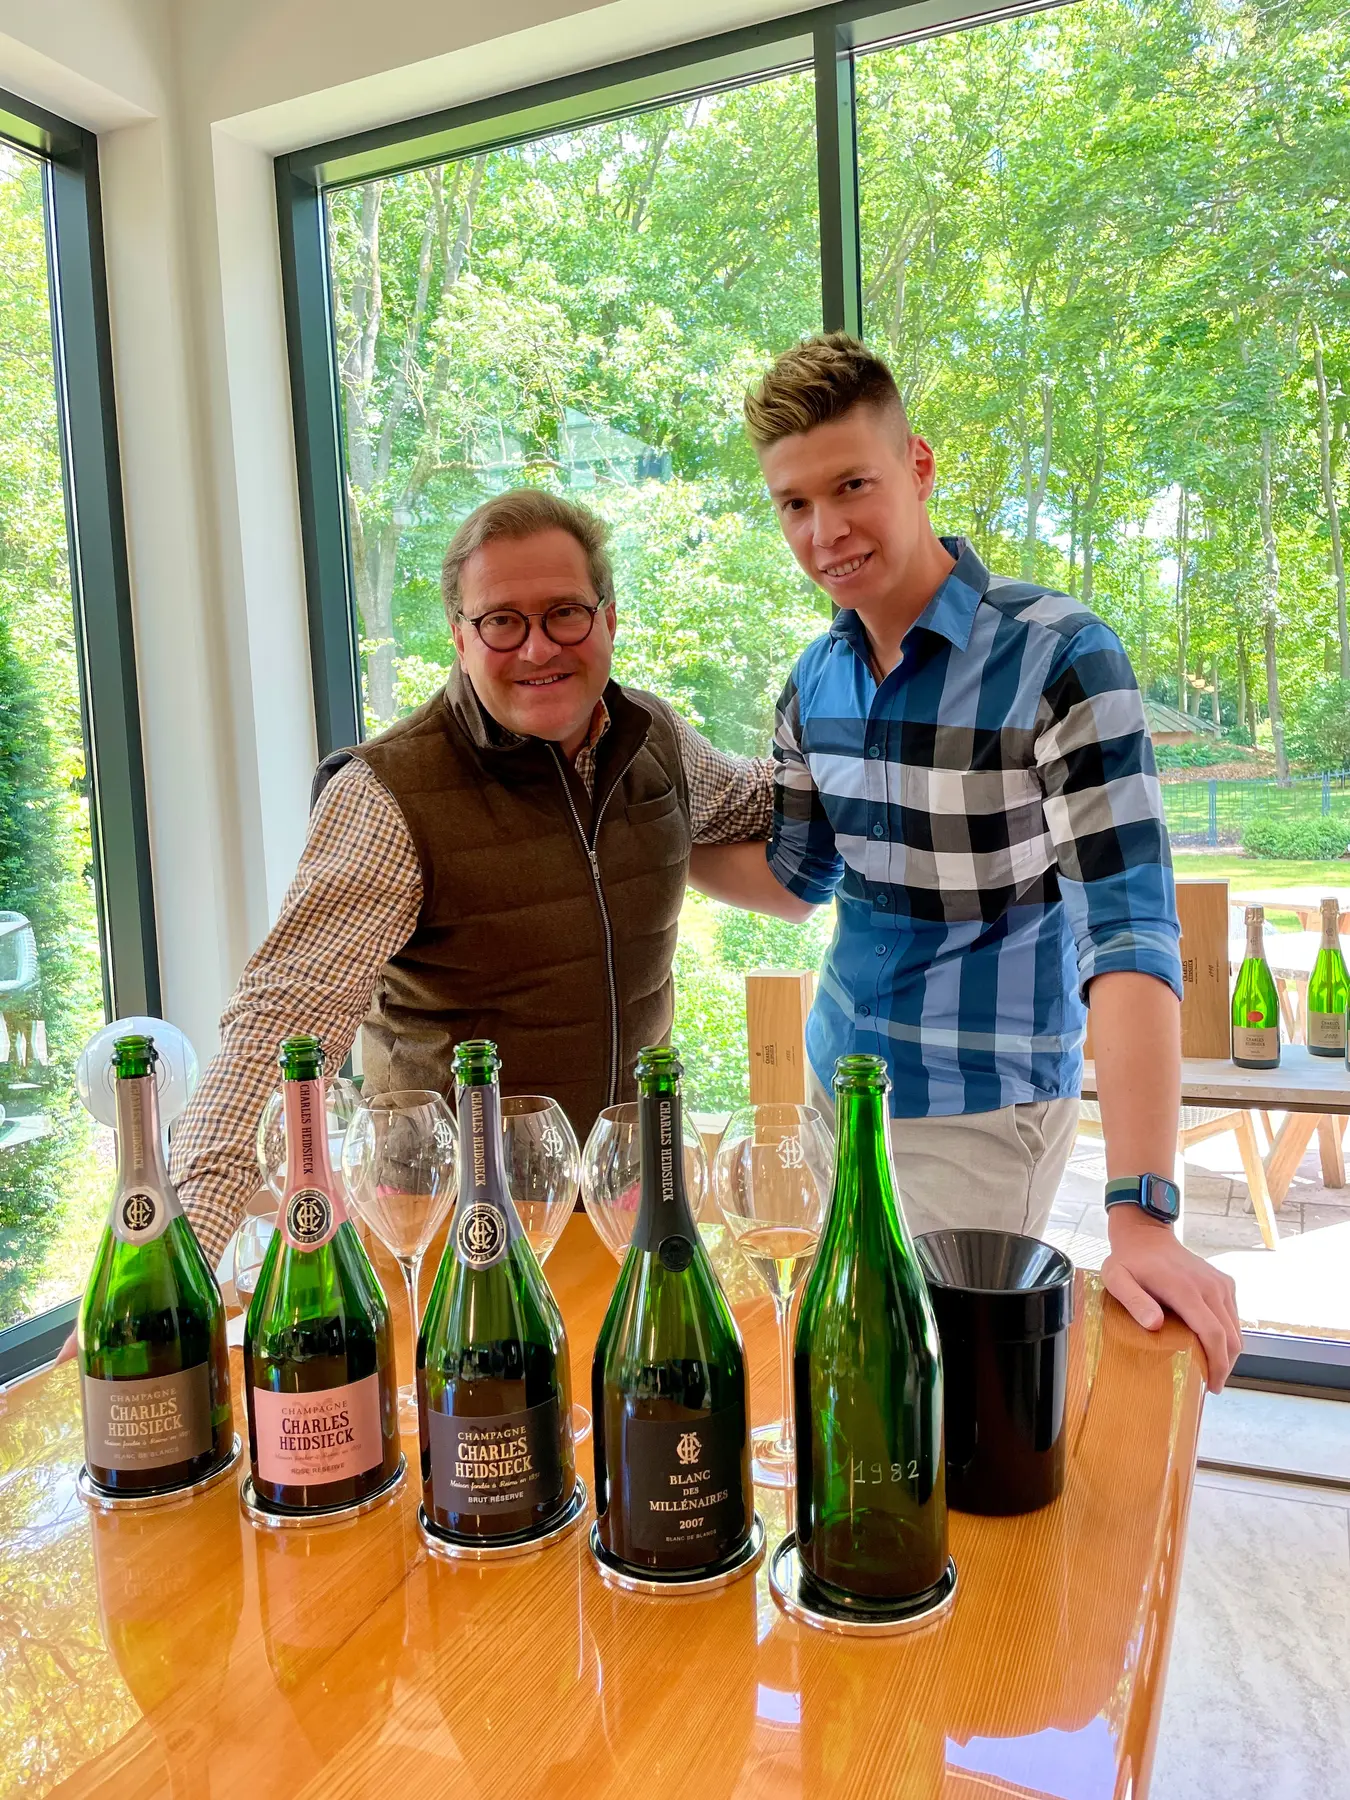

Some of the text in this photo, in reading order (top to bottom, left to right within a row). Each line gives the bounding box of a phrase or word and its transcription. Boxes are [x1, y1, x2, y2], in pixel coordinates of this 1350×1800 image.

[300, 1084, 314, 1175] CHARLES HEIDSIECK
[471, 1091, 487, 1187] CHARLES HEIDSIECK
[660, 1100, 674, 1202] CHARLES HEIDSIECK
[110, 1388, 177, 1402] CHAMPAGNE
[110, 1397, 178, 1421] CHARLES
[281, 1400, 348, 1416] CHAMPAGNE
[108, 1414, 183, 1437] HEIDSIECK
[282, 1410, 350, 1435] CHARLES
[458, 1426, 527, 1441] CHAMPAGNE
[279, 1427, 355, 1451] HEIDSIECK
[458, 1436, 528, 1461] CHARLES
[455, 1455, 533, 1479] HEIDSIECK
[670, 1469, 711, 1485] BLANC
[854, 1460, 919, 1484] 1982
[450, 1480, 469, 1489] Maison
[683, 1487, 699, 1496] DES
[649, 1489, 728, 1512] MILLÉNAIRES
[679, 1517, 705, 1530] 2007
